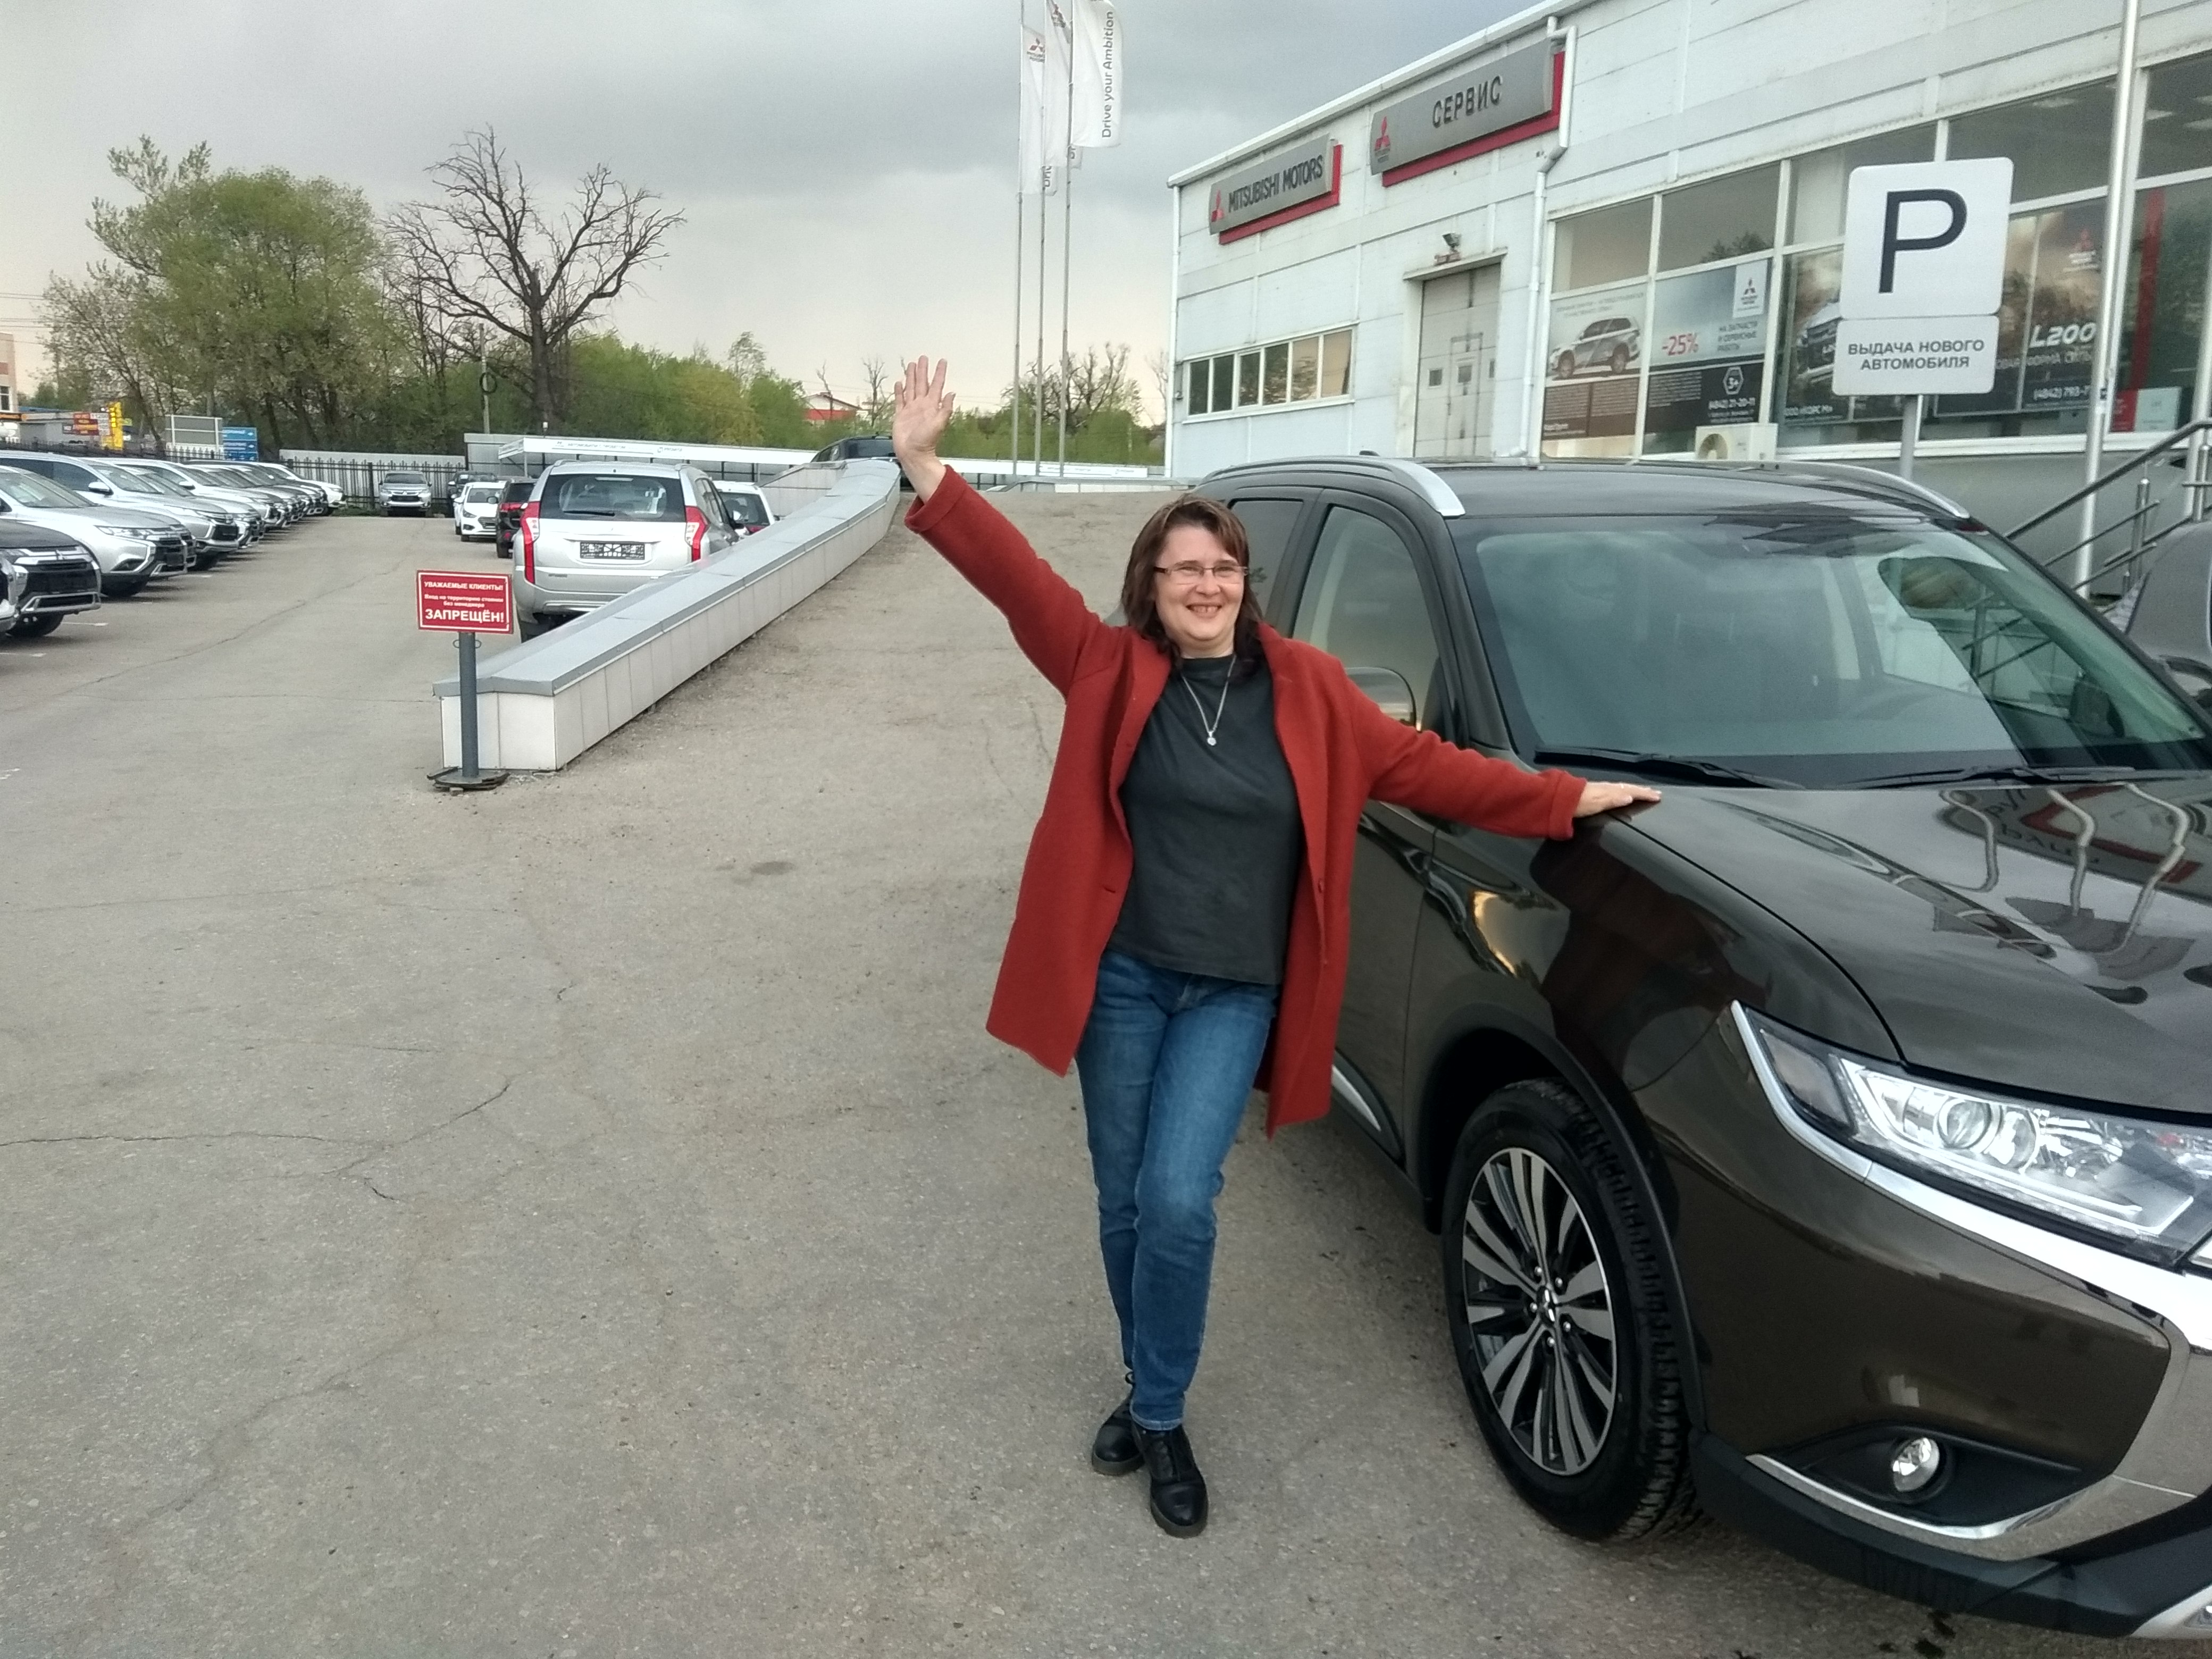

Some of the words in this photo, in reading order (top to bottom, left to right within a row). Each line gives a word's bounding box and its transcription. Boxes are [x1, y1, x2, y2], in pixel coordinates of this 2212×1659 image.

[1103, 11, 1114, 70] Ambition
[1105, 72, 1114, 100] your
[1432, 75, 1503, 128] СЕРВИС
[1102, 104, 1112, 137] Drive
[1228, 172, 1280, 213] MITSUBISHI
[1283, 154, 1323, 192] MOTORS
[1879, 189, 1967, 293] P
[1662, 332, 1700, 356] -25%
[1848, 342, 1914, 356] ВЫДАЧА
[1918, 339, 1985, 353] НОВОГО
[2030, 322, 2097, 347] L200
[1861, 356, 1970, 370] АВТОМОБИЛЯ
[425, 609, 505, 623] ЗАПРЕЩЁН!
